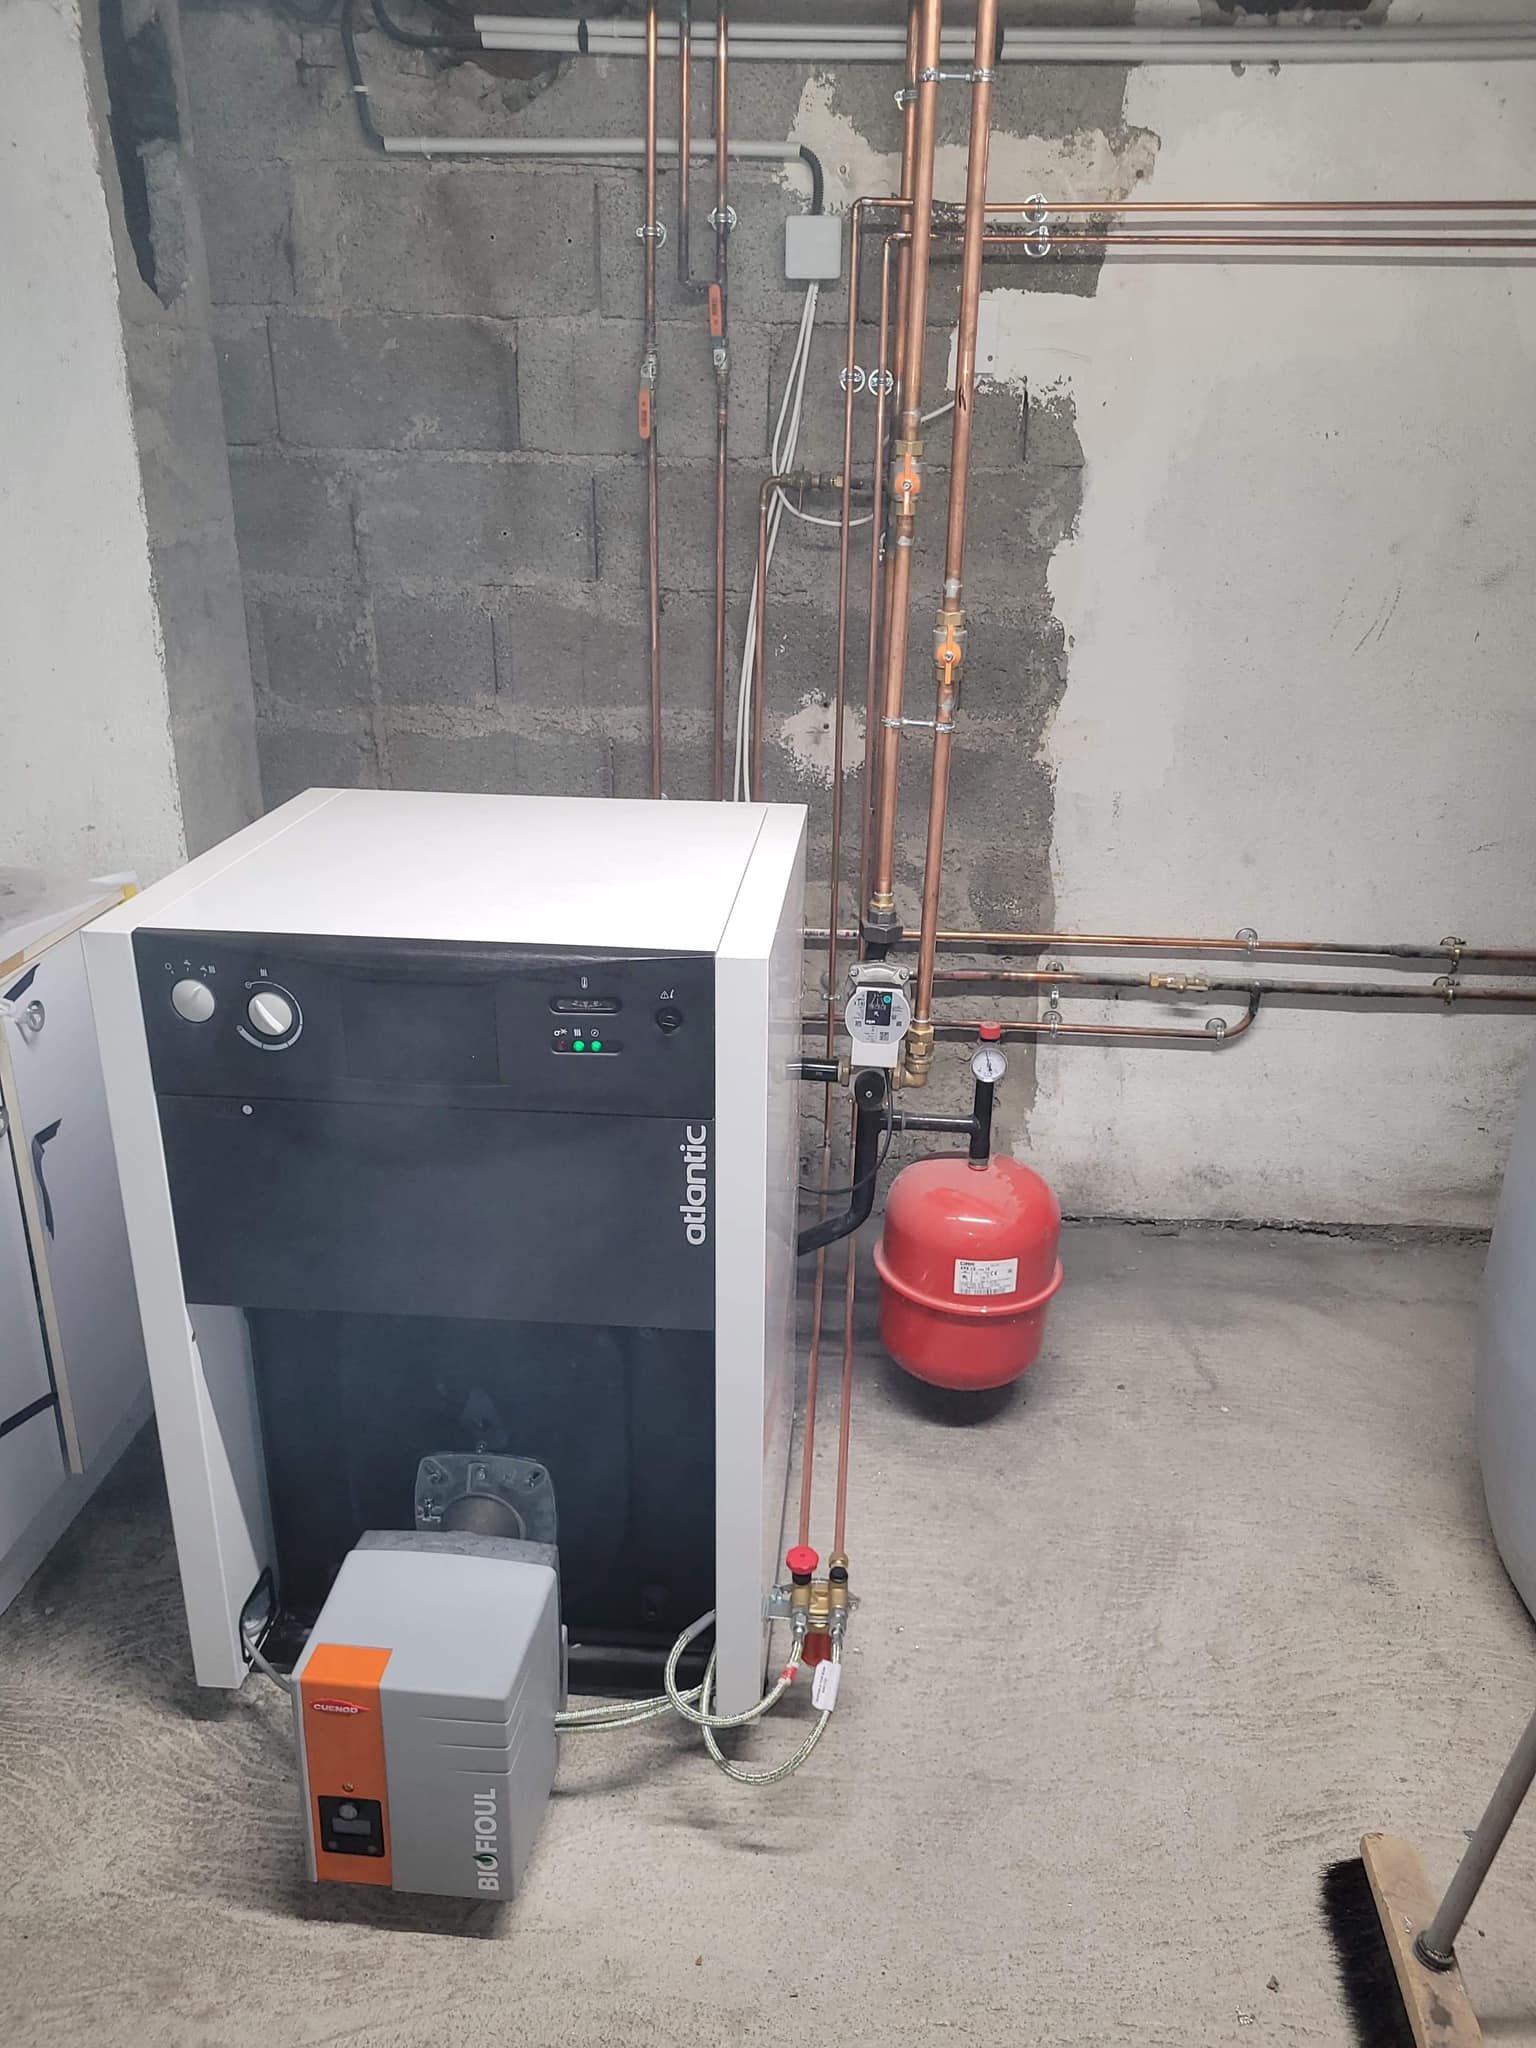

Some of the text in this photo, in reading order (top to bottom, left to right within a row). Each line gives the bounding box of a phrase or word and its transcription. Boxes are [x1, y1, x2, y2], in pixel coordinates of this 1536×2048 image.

[679, 1124, 707, 1246] atlantic
[313, 1703, 358, 1714] CUENOD
[473, 1788, 499, 1890] BIOFIOUL
